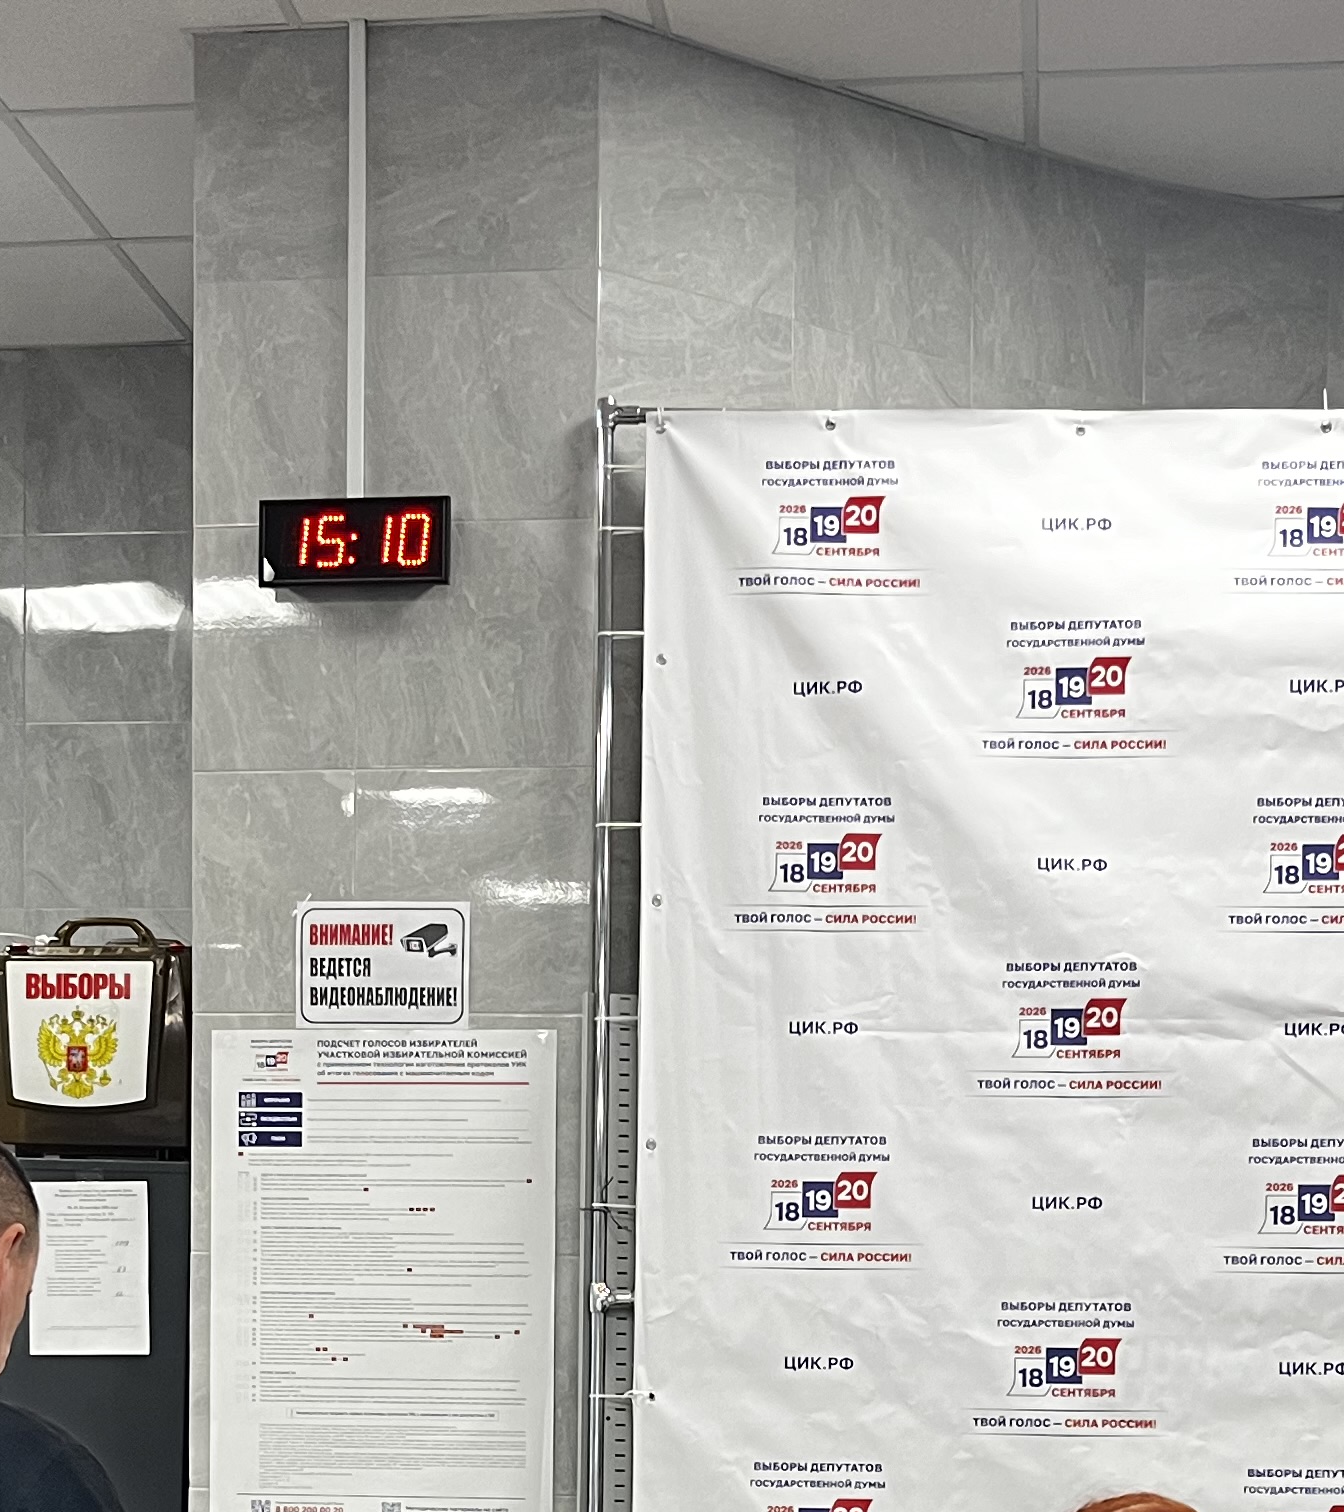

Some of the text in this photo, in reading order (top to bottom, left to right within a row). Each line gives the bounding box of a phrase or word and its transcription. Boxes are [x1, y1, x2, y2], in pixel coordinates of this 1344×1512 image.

[1041, 517, 1112, 532] ЦИК.РФ
[299, 512, 432, 568] 15:10
[793, 679, 863, 697] ЦИК.РФ
[1037, 856, 1108, 873] ЦИК.РФ
[310, 924, 393, 945] ВНИМАНИЕ!
[310, 958, 371, 979] ВЕДЕТСЯ
[1006, 962, 1137, 972] ВЫБОРЫ ДЕПУТАТОВ
[26, 973, 131, 999] ВЫБОРЫ
[1002, 978, 1140, 989] ГОСУДАРСТВЕННОЙ ДУМЫ
[310, 987, 457, 1009] ВИДЕОНАБЛЮДЕНИЕ!
[789, 1020, 859, 1037] ЦИК.РФ
[1023, 1007, 1118, 1049] 18 19 20
[317, 1038, 477, 1048] ПОДСЧЕТ ГОЛОСОВ ИЗБИРАТЕЛЕЙ
[317, 1049, 527, 1059] УЧАСТКОВОЙ ИЗБИРАТЕЛЬНОЙ КОМИССИЕЙ
[1057, 1050, 1121, 1058] СЕНТЯБРЯ
[977, 1078, 1161, 1089] ТВОЙ ГОЛОС СИЛА РОССИИ!
[1252, 1139, 1307, 1147] ВЫБОРЫ
[1031, 1195, 1103, 1212] ЦИК.РФ
[1270, 1206, 1295, 1225] 18
[1301, 1193, 1328, 1214] 19
[1224, 1254, 1256, 1265] ТВОЙ
[1260, 1256, 1302, 1265] ГОЛОС
[784, 1355, 854, 1372] ЦИК.РФ
